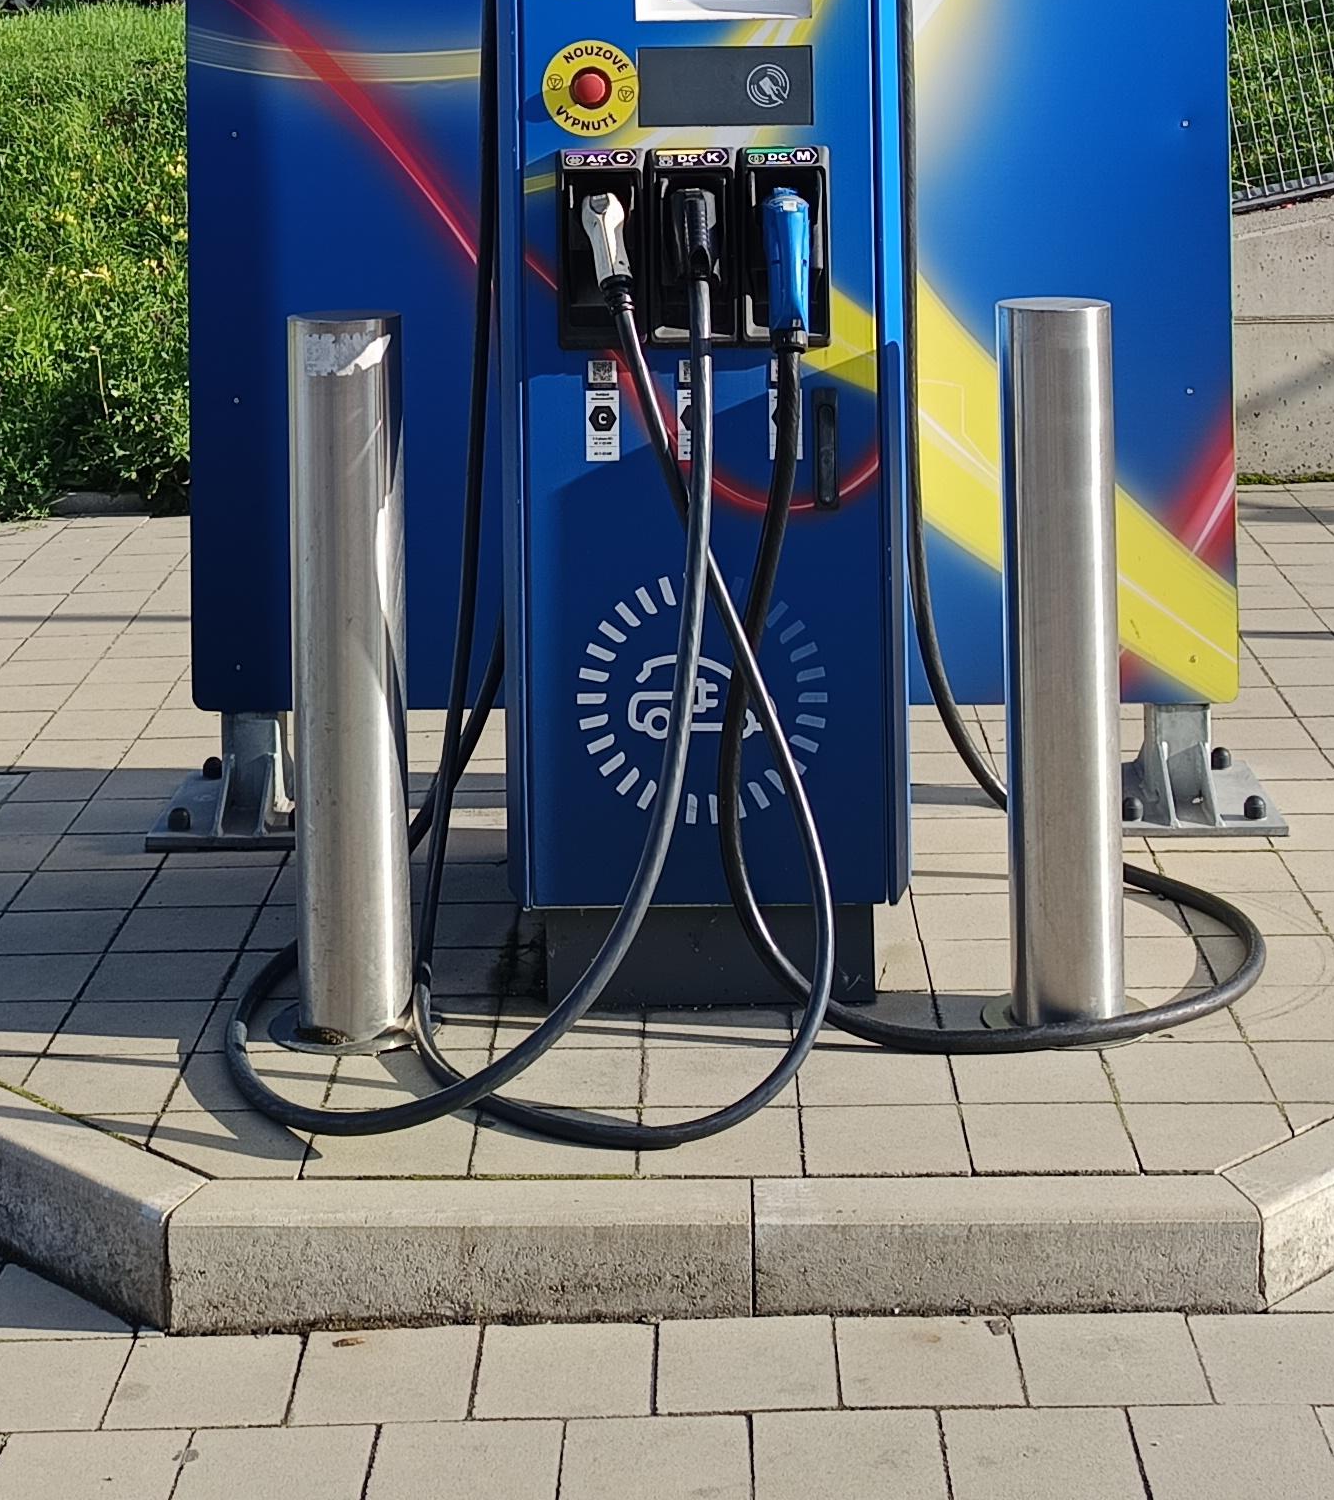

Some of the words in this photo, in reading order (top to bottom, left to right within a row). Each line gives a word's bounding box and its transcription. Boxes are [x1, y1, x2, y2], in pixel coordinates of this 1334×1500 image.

[563, 45, 630, 73] NOUZOVÉ
[556, 105, 618, 131] VYPNUTÍ
[586, 154, 608, 163] AC
[616, 153, 629, 163] C
[677, 154, 698, 162] DC
[707, 152, 720, 162] K
[767, 153, 788, 161] DC
[797, 151, 811, 161] M
[598, 412, 608, 425] C
